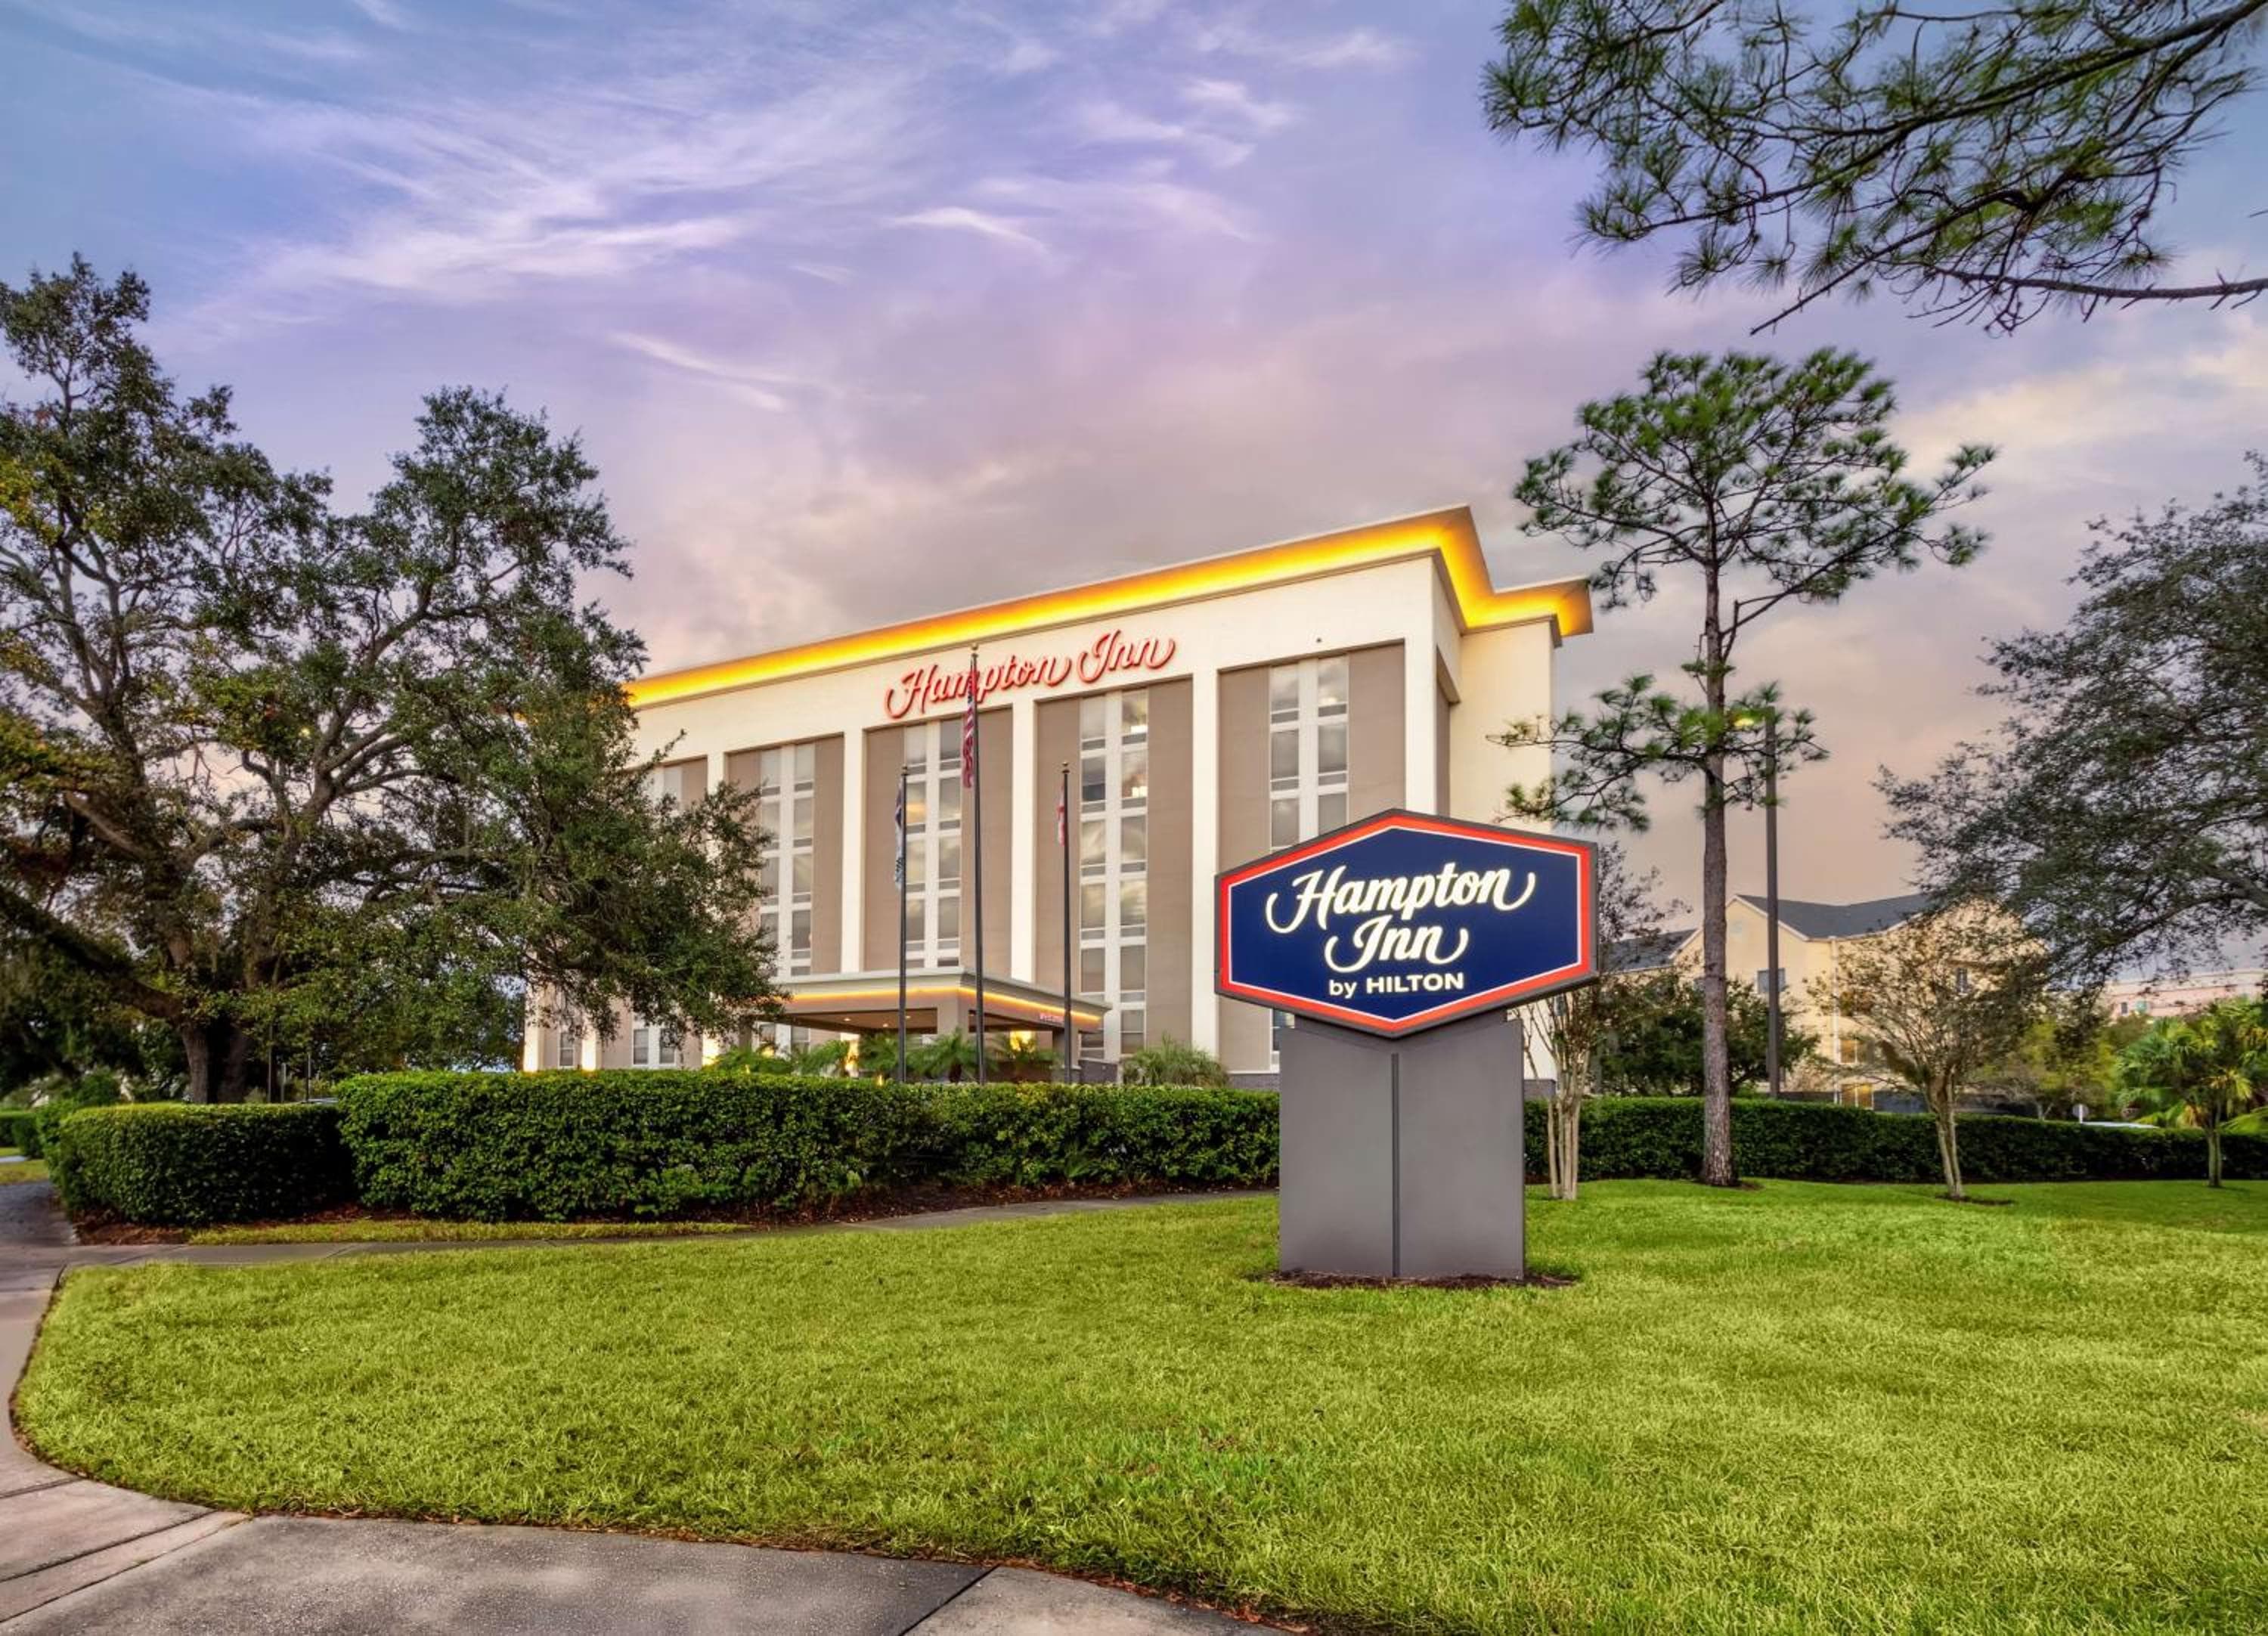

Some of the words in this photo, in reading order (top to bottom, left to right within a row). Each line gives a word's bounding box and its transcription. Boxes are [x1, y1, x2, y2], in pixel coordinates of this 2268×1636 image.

[885, 655, 1073, 719] Hampton
[1078, 630, 1176, 683] Inn
[1265, 861, 1536, 934] Hampton
[1324, 914, 1470, 973] Inn
[1328, 979, 1358, 999] by
[1365, 972, 1464, 995] HILTON
